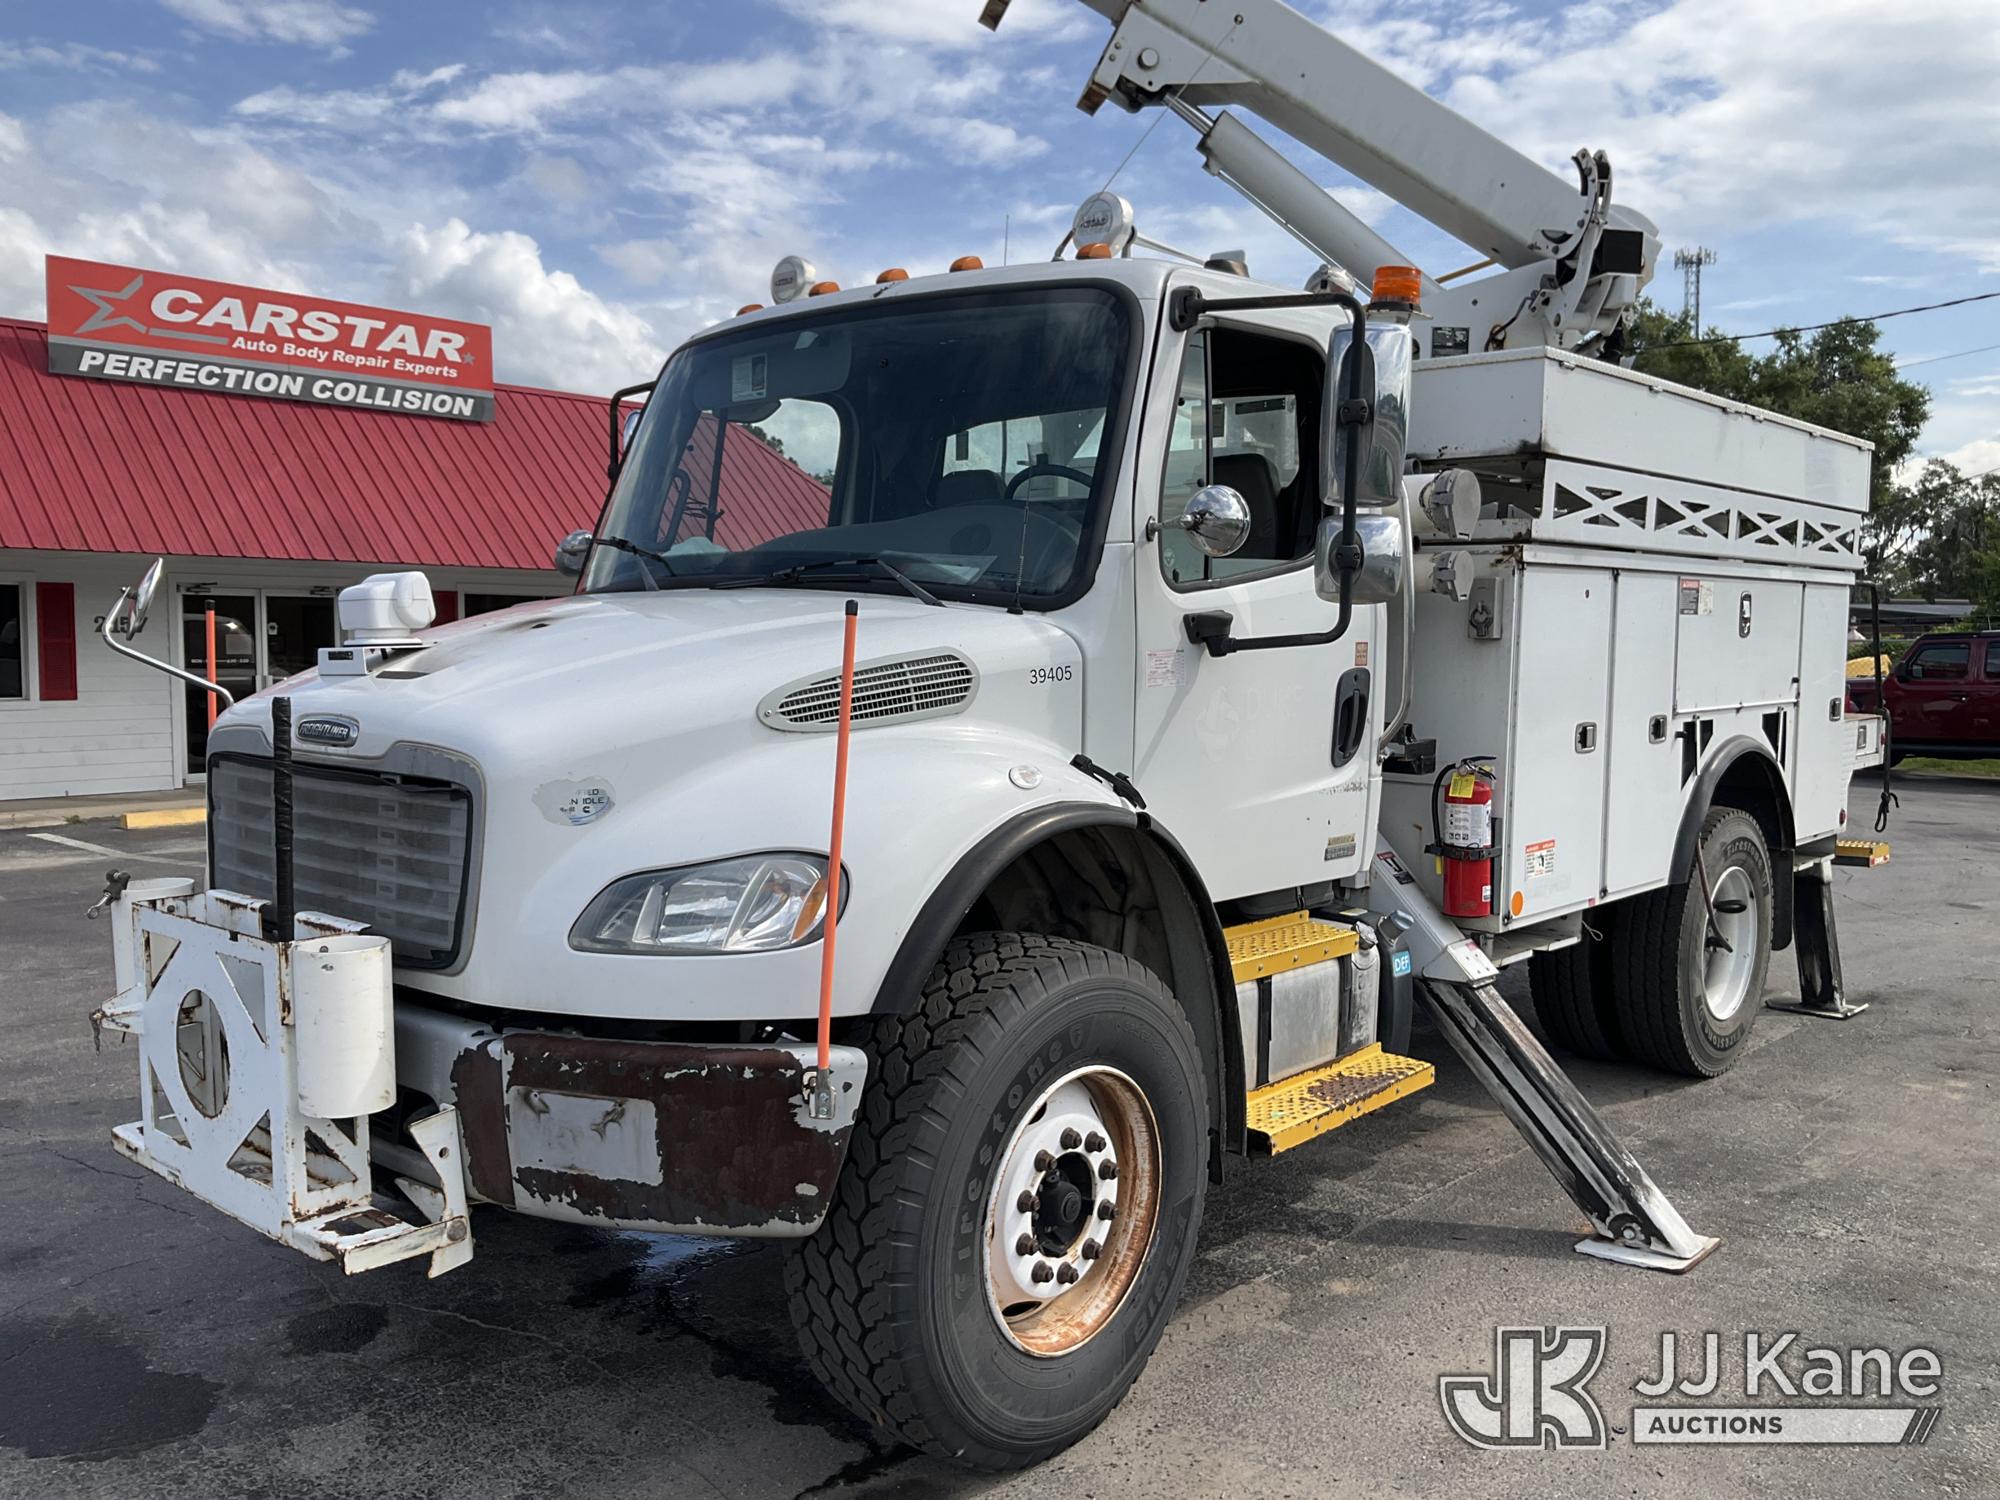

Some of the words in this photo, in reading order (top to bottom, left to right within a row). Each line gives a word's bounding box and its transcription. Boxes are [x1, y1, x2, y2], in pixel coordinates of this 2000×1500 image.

[150, 288, 466, 363] CARSTAR
[231, 336, 278, 353] Auto
[283, 343, 328, 363] Body
[332, 349, 390, 369] Repair
[393, 358, 458, 378] Experts
[78, 350, 304, 396] PERFECTION
[312, 379, 475, 417] COLLISION
[1029, 665, 1073, 685] 39405
[582, 796, 605, 805] IDLE
[1394, 955, 1410, 972] DEF
